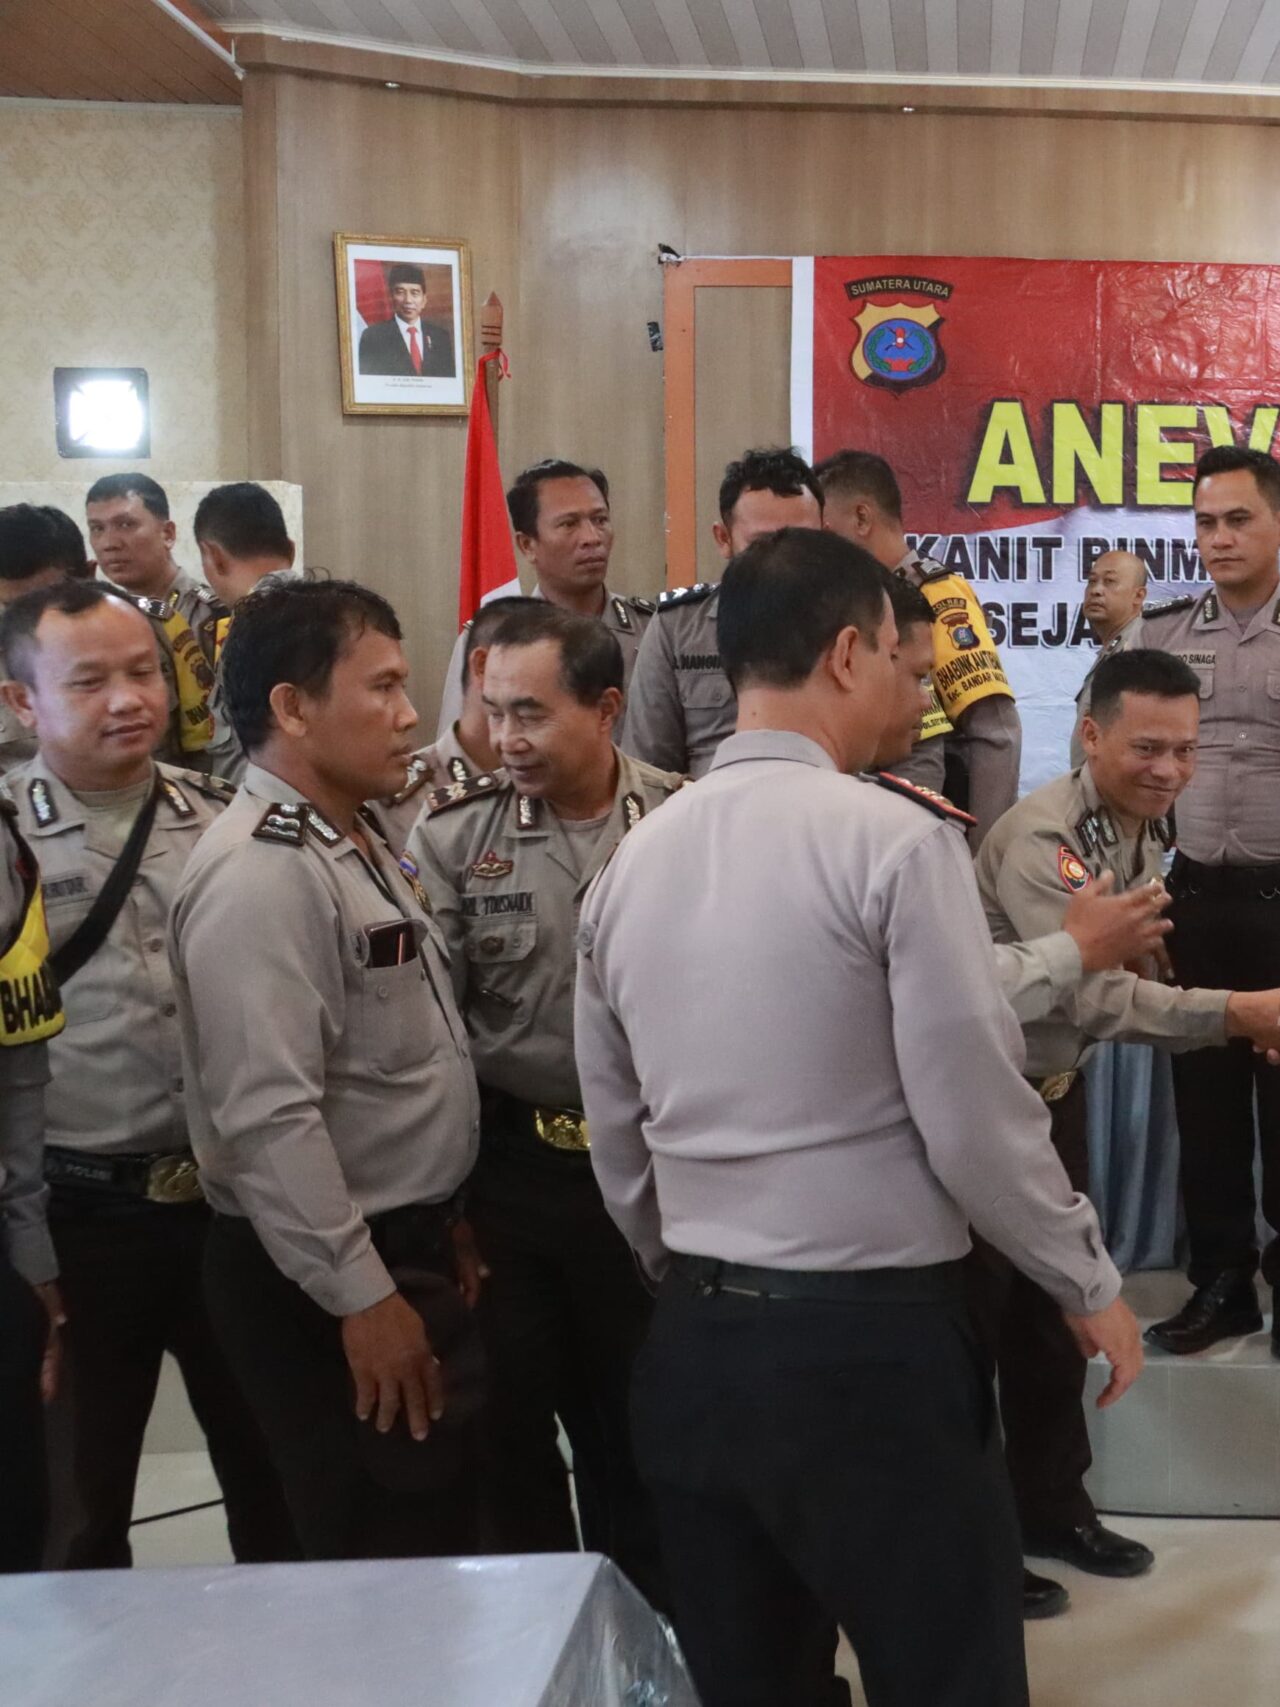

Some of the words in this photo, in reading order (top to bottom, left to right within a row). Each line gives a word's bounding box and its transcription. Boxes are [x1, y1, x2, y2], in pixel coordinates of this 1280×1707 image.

[850, 279, 911, 296] SUMATERA
[913, 280, 949, 297] UTARA
[1189, 653, 1216, 665] SINAGA
